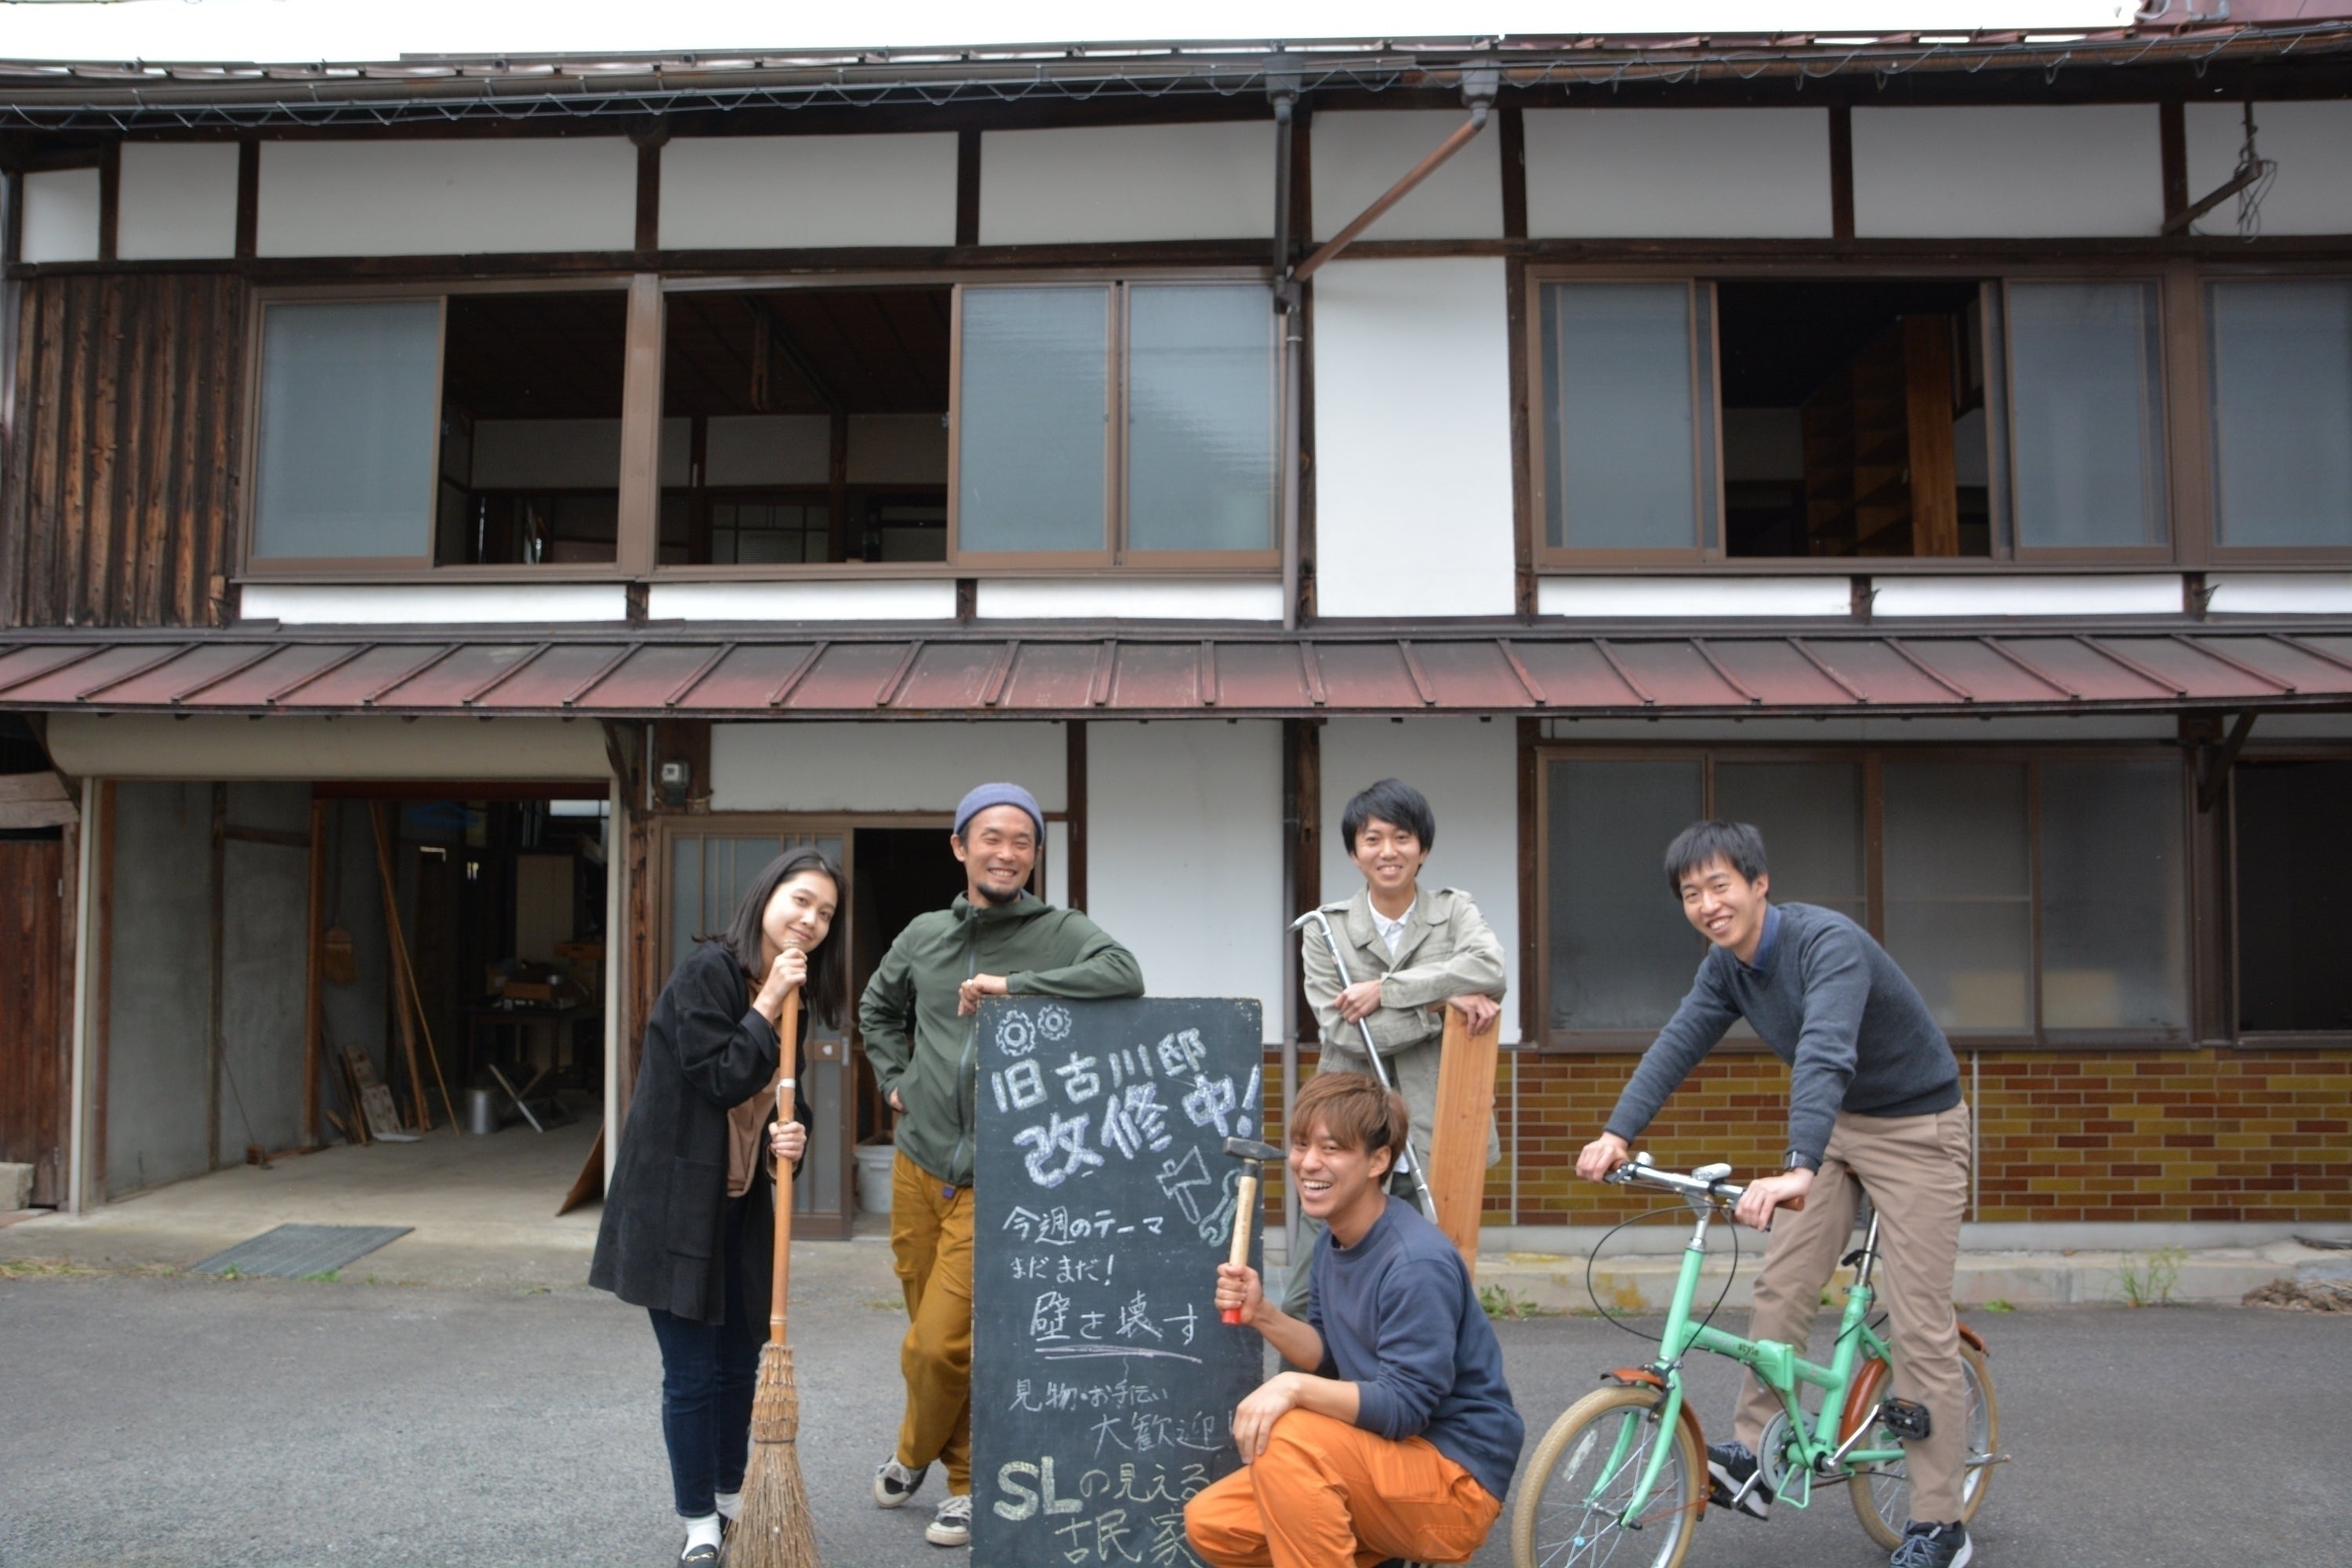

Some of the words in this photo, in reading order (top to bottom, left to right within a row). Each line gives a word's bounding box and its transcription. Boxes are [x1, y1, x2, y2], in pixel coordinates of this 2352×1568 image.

[992, 1027, 1207, 1113] 旧古川邸
[1002, 1205, 1163, 1245] 今週のテーマ
[1030, 1290, 1198, 1346] 壁を壊す
[993, 1455, 1211, 1521] SLの見える
[1054, 1507, 1204, 1568] 古民家
